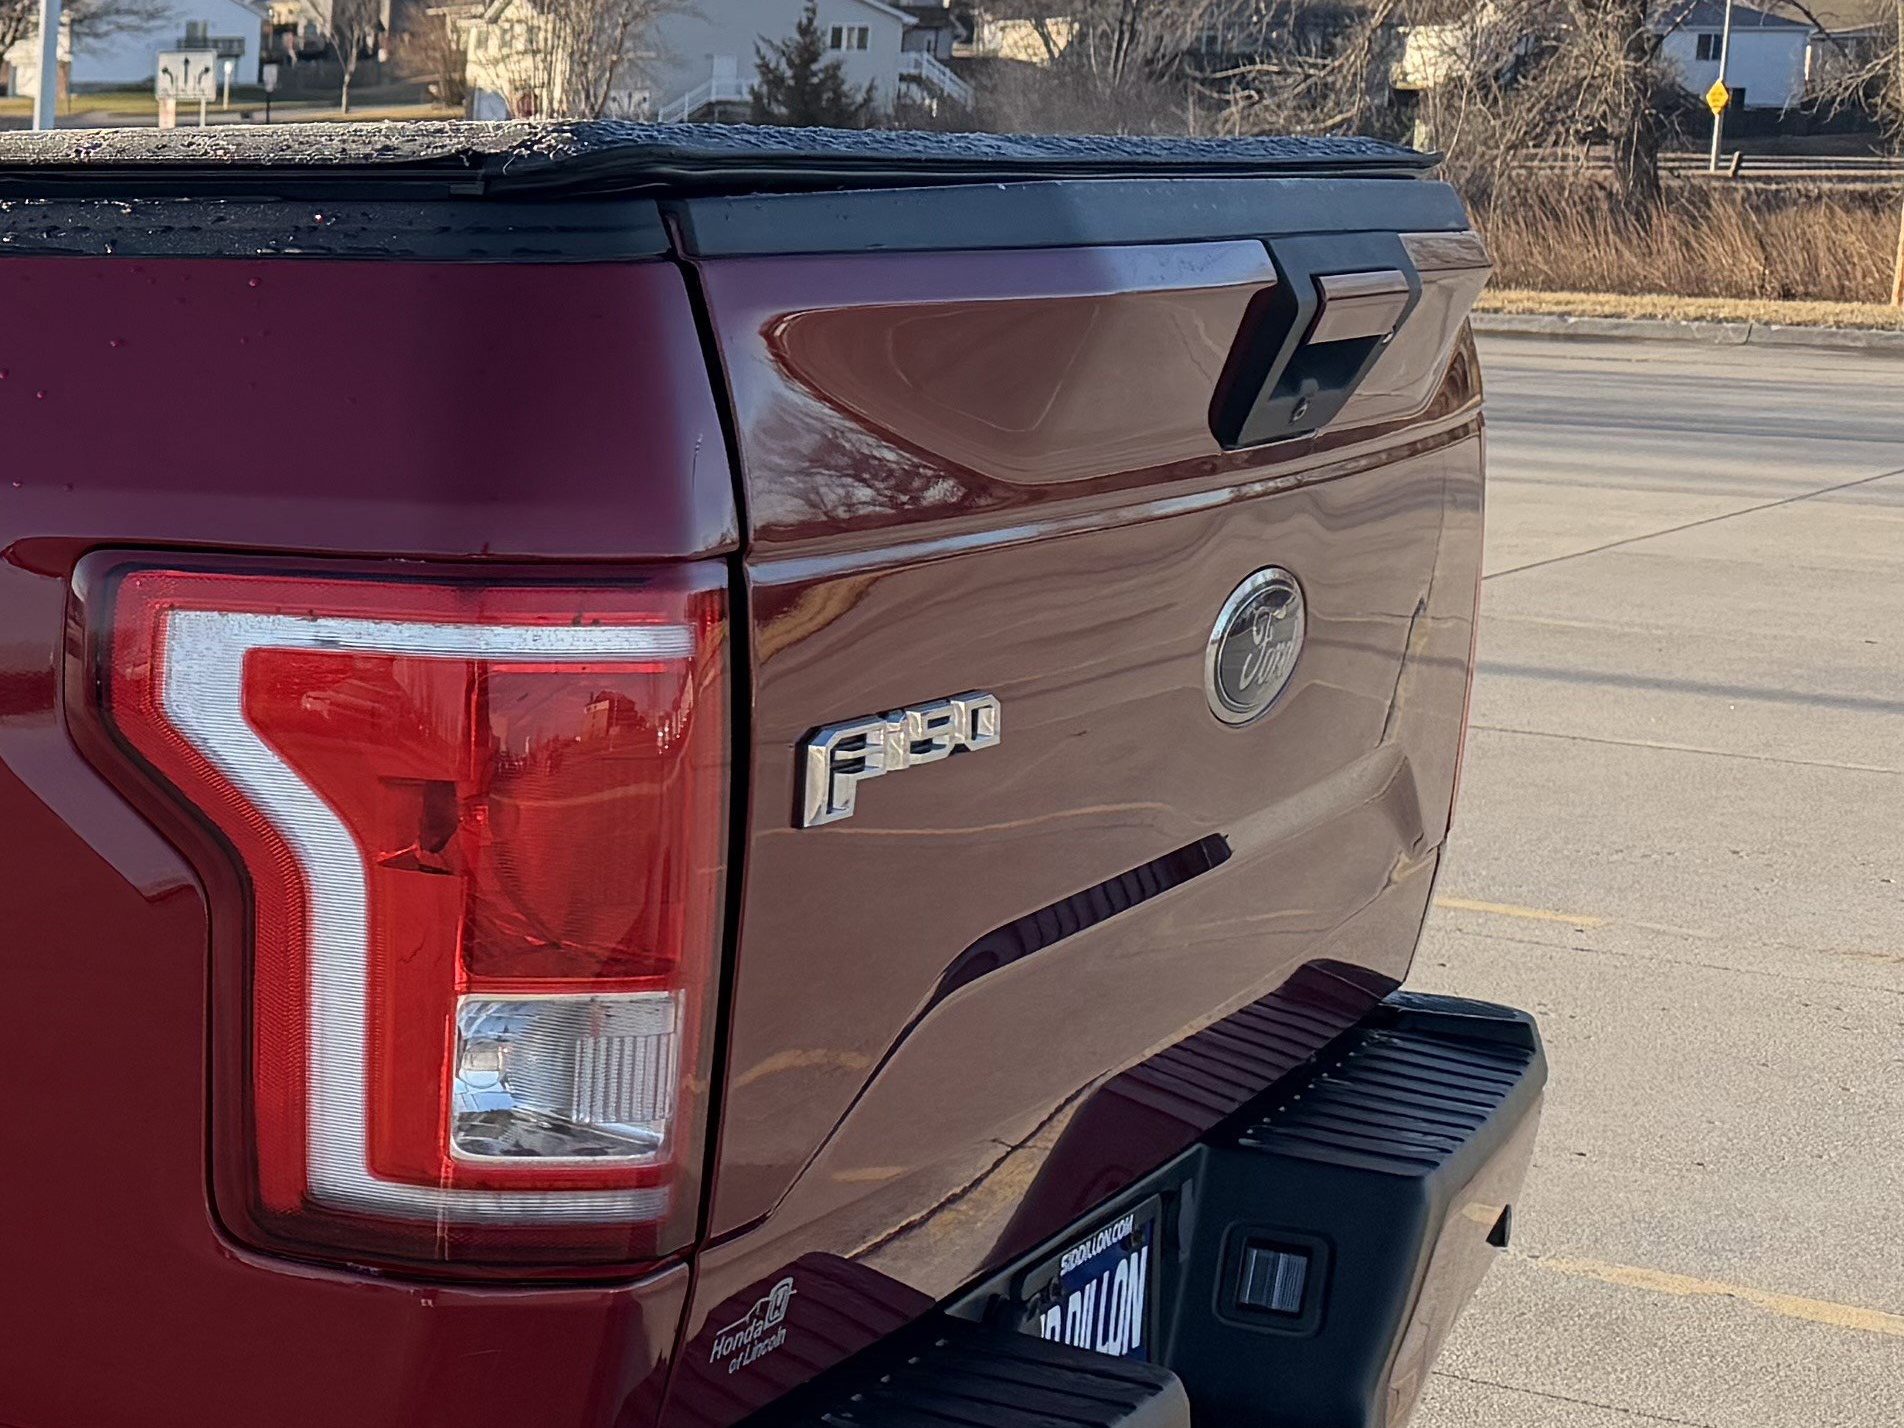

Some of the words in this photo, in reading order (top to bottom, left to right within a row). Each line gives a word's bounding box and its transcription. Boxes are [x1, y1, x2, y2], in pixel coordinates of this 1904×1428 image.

[1239, 604, 1298, 692] Ford
[709, 1318, 764, 1364] Honda
[728, 1352, 742, 1374] of
[742, 1325, 787, 1367] Lincoln
